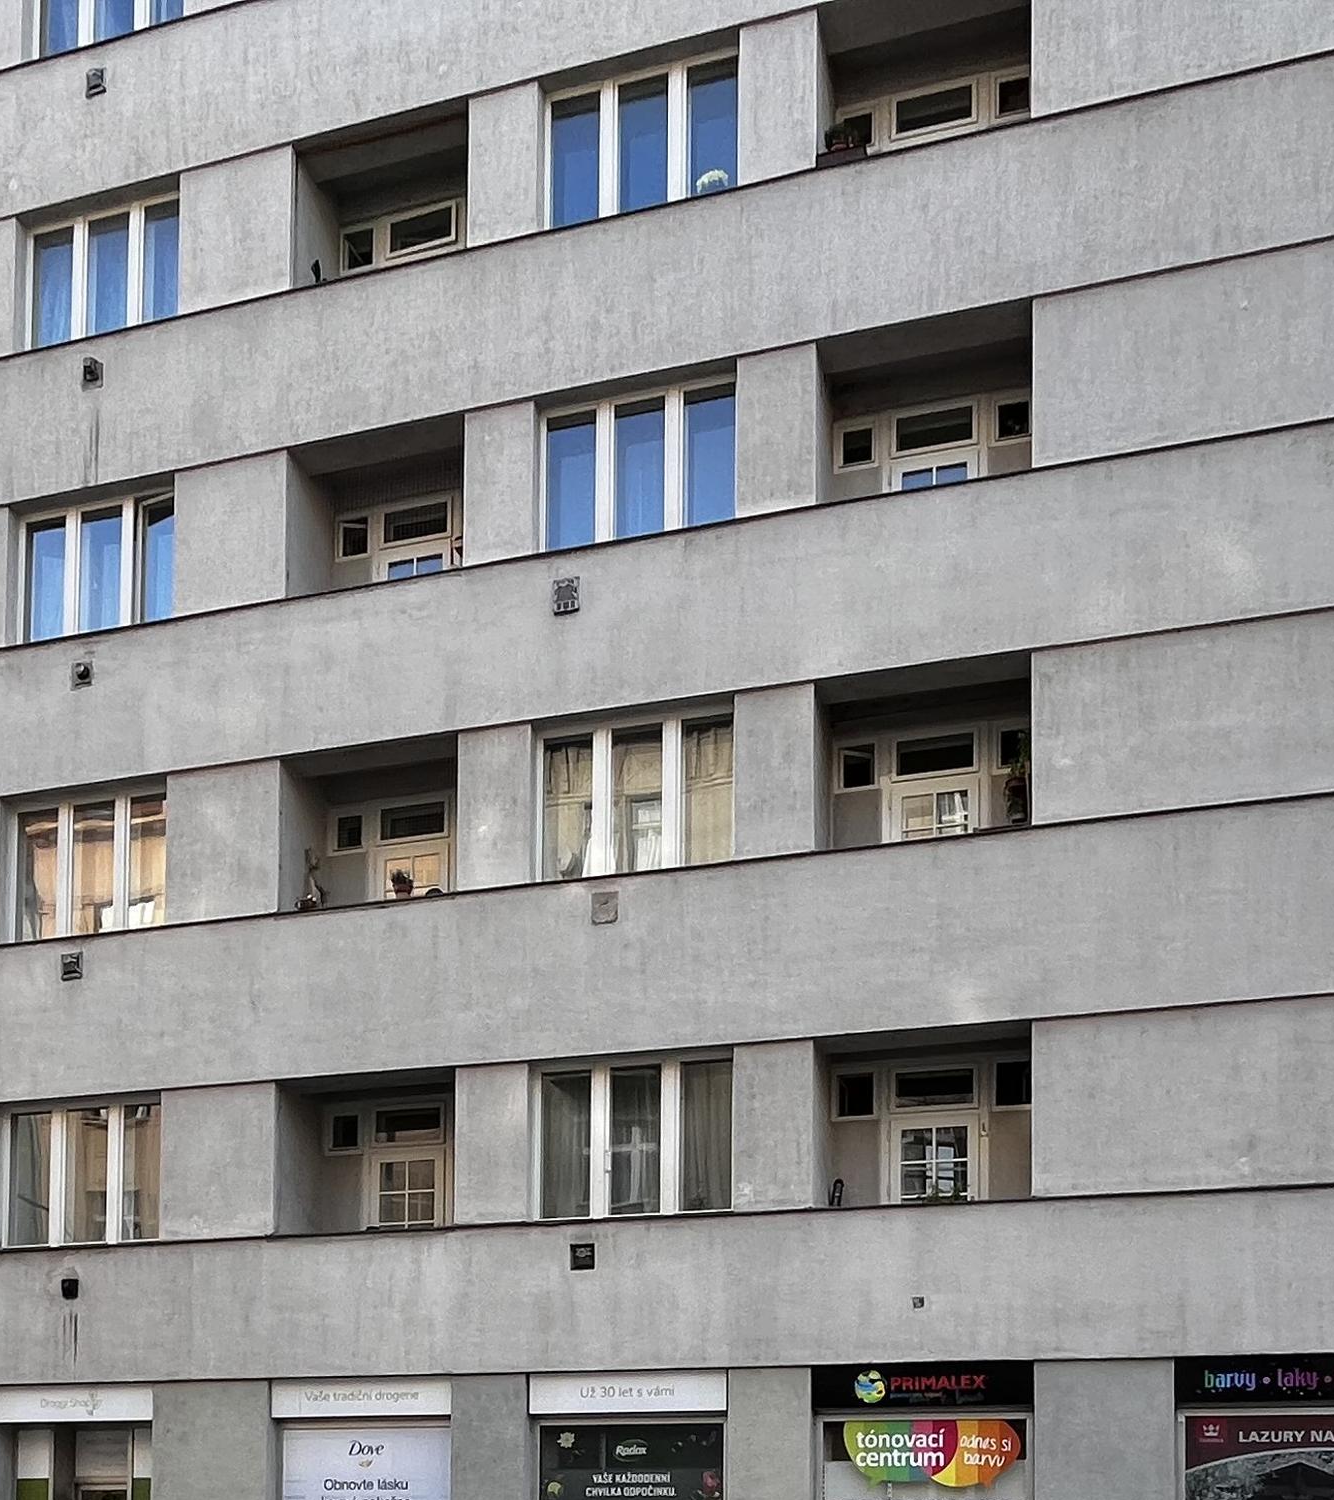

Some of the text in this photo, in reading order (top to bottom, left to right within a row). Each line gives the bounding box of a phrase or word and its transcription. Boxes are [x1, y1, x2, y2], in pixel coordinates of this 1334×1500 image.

[890, 1375, 986, 1391] PRIMALEX
[1204, 1370, 1256, 1390] barvy
[1277, 1368, 1318, 1390] laky
[305, 1390, 330, 1401] Vaše
[580, 1385, 675, 1398] Už 30 let s vámi
[856, 1429, 945, 1448] tónovací
[1001, 1436, 1012, 1451] si
[1239, 1430, 1305, 1443] LAZURY
[1310, 1430, 1334, 1442] NA
[349, 1440, 385, 1456] Dove
[856, 1450, 945, 1467] centrum
[964, 1452, 1005, 1467] barvu
[324, 1479, 409, 1490] Obnovte lásku
[592, 1472, 671, 1484] VAŠE KAŽDODENNÍ
[585, 1487, 622, 1497] CHVILKA
